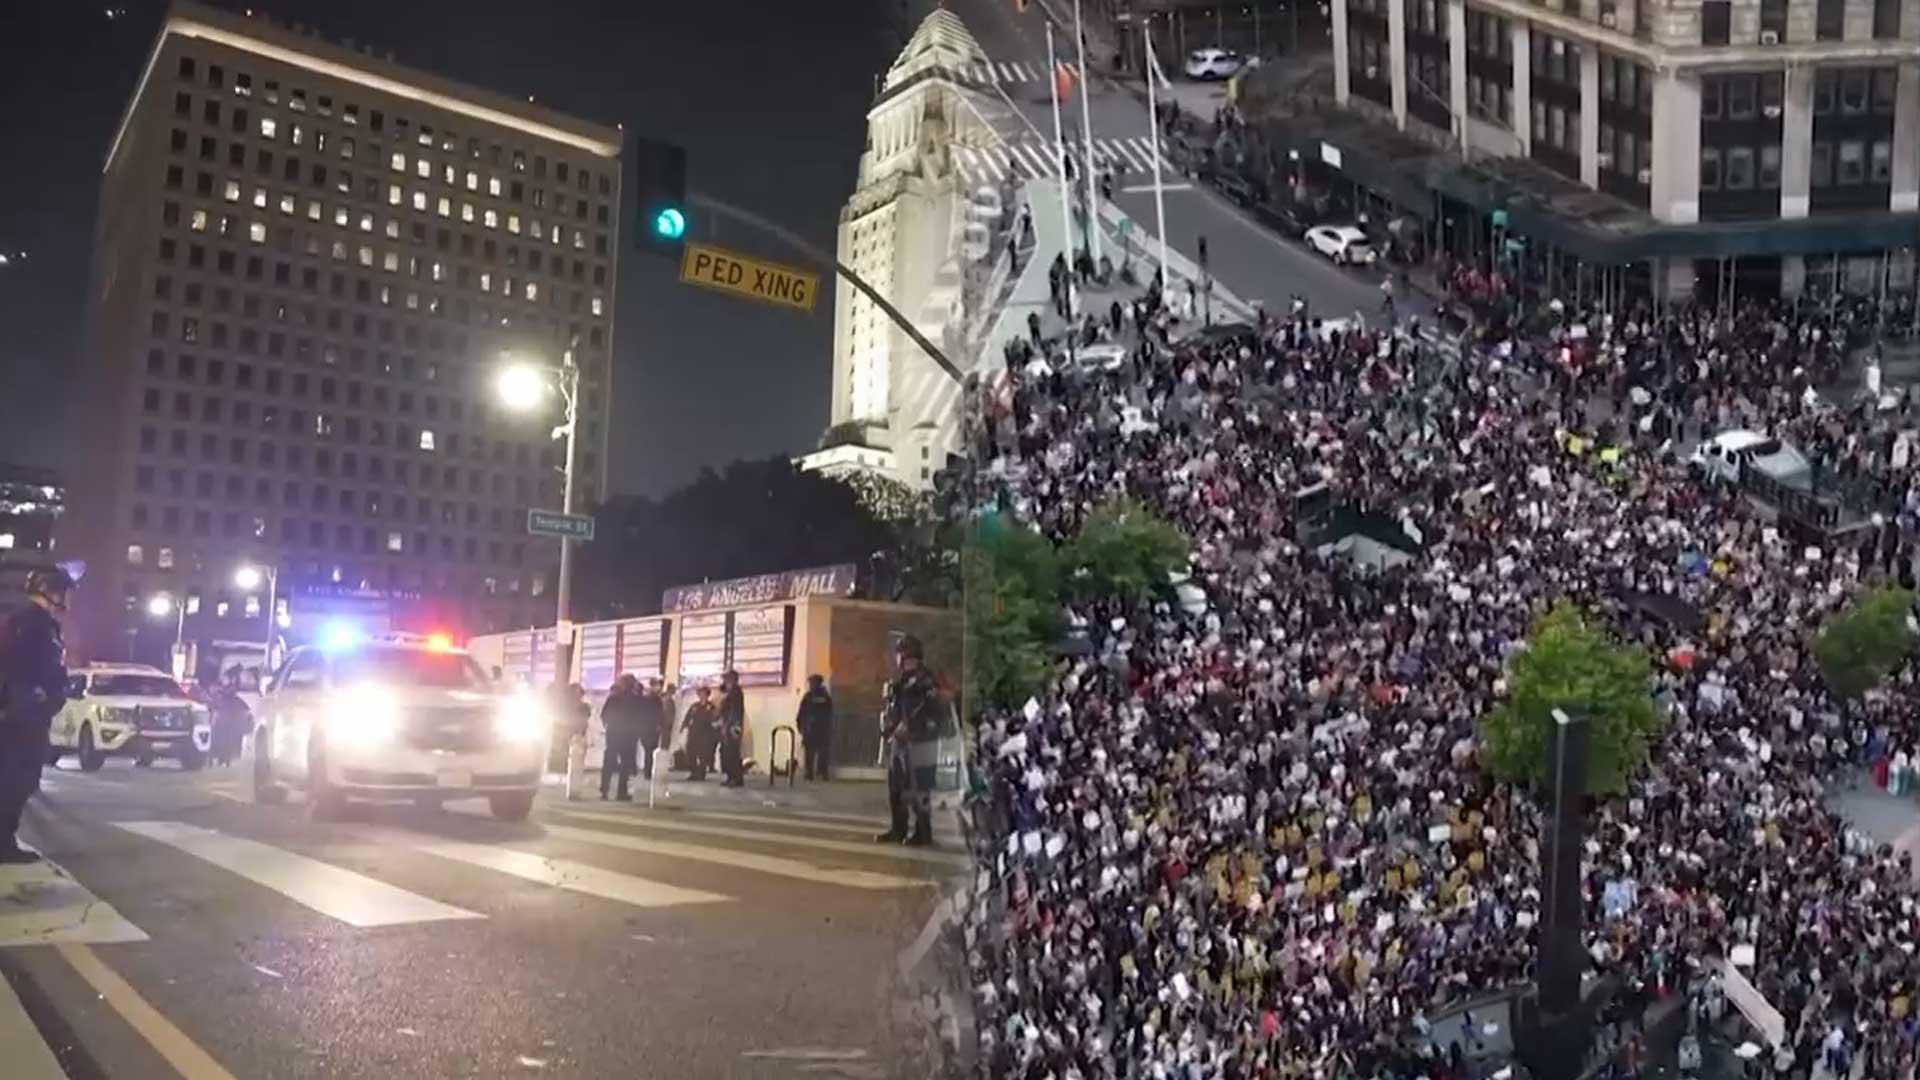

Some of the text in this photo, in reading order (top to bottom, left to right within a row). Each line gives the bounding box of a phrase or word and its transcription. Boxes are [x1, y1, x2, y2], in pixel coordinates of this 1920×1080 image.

[695, 254, 806, 302] PED XING
[790, 573, 836, 597] MALL
